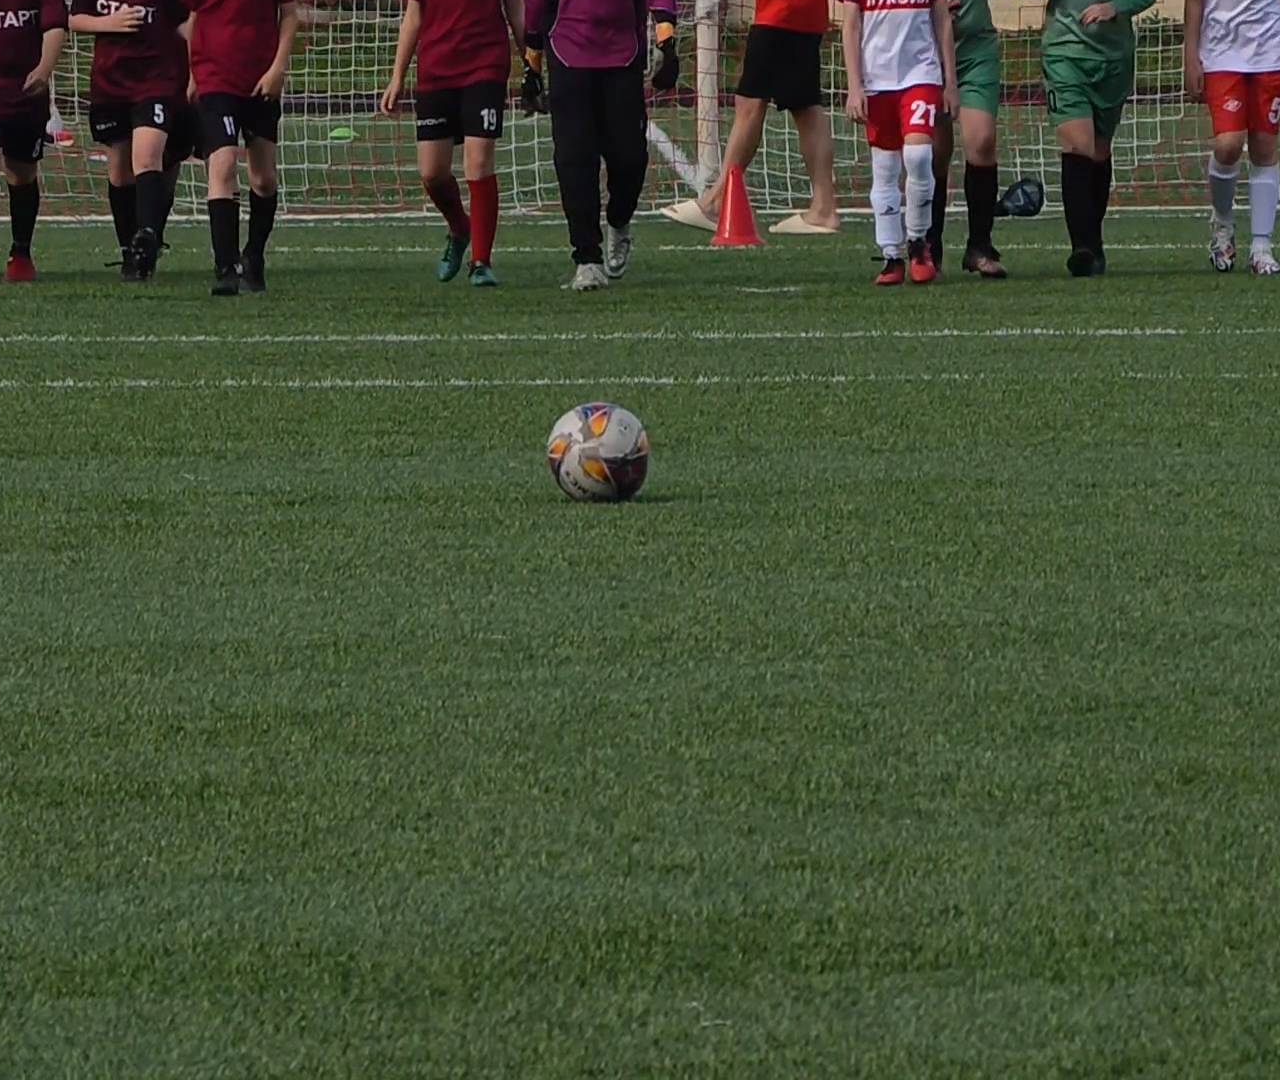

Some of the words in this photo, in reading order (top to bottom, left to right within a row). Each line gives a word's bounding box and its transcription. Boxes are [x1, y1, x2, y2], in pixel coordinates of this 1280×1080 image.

[153, 103, 165, 125] 5
[480, 108, 497, 131] 19
[909, 99, 936, 127] 21
[223, 115, 236, 136] 11
